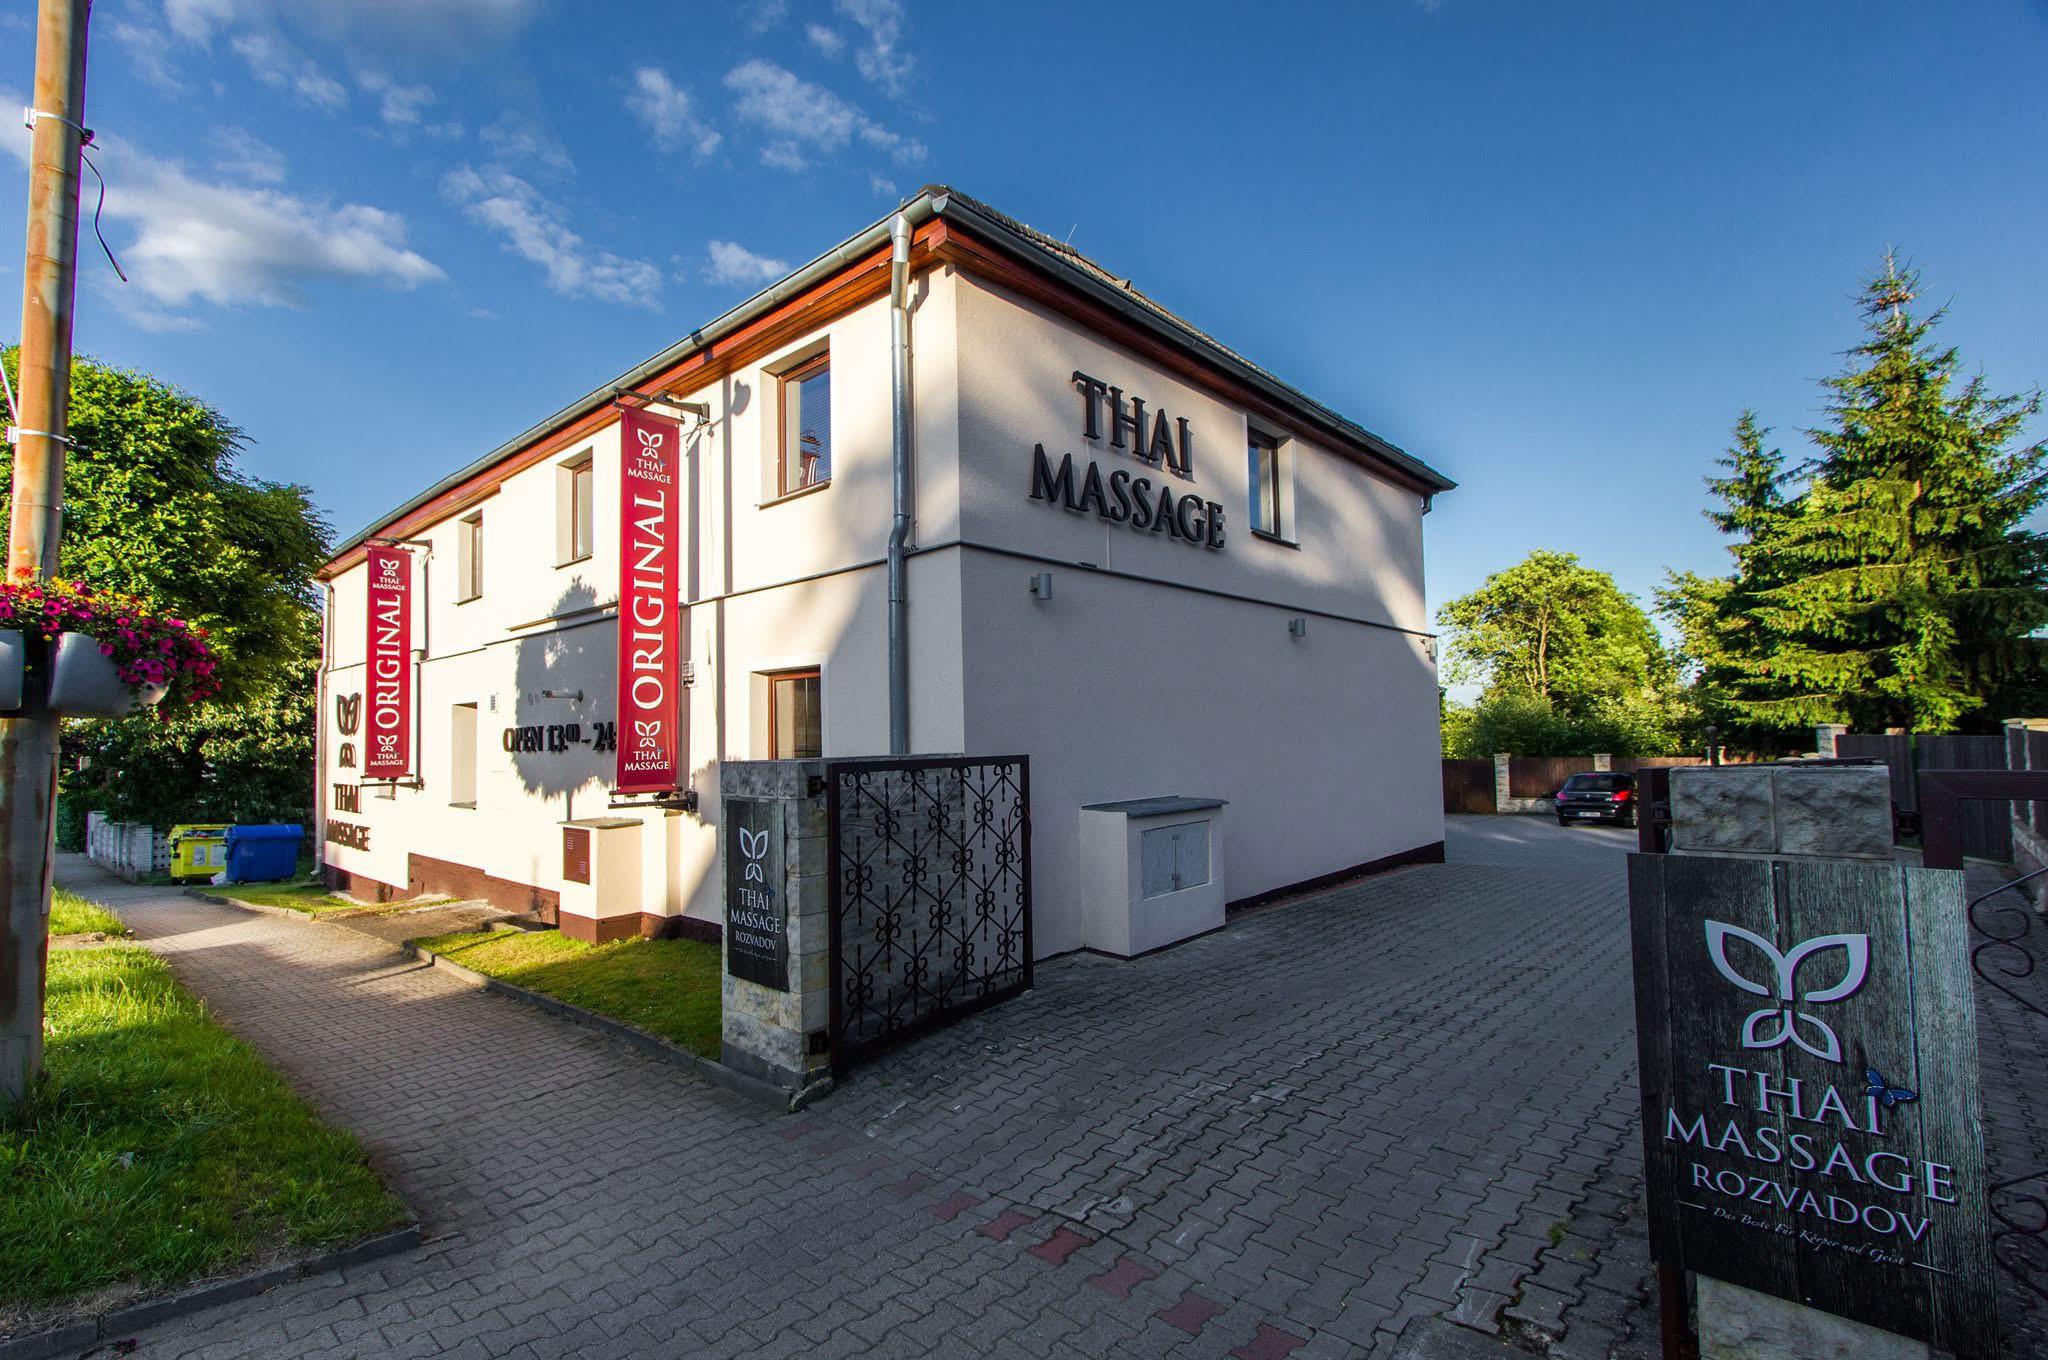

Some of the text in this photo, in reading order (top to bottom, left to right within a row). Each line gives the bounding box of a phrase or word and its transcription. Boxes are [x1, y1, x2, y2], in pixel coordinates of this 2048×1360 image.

[1072, 370, 1192, 474] THAI
[627, 468, 672, 484] MASSAGE
[636, 458, 663, 472] THAI
[1029, 443, 1225, 549] MASSAGE
[372, 583, 406, 591] MASSAGE
[379, 576, 400, 585] THAI
[632, 490, 666, 710] ORIGINAL
[376, 594, 401, 729] ORIGINAL
[503, 726, 544, 752] OPEN
[376, 752, 398, 760] THAI
[625, 761, 669, 771] MASSAGE
[633, 750, 661, 760] THAI
[739, 887, 769, 911] THAI
[730, 908, 781, 934] MASSAGE
[735, 930, 777, 951] ROZVADOV
[1708, 1063, 1887, 1136] THAI
[1664, 1107, 1958, 1204] MASSAGE
[1690, 1161, 1932, 1242] ROZVADOV
